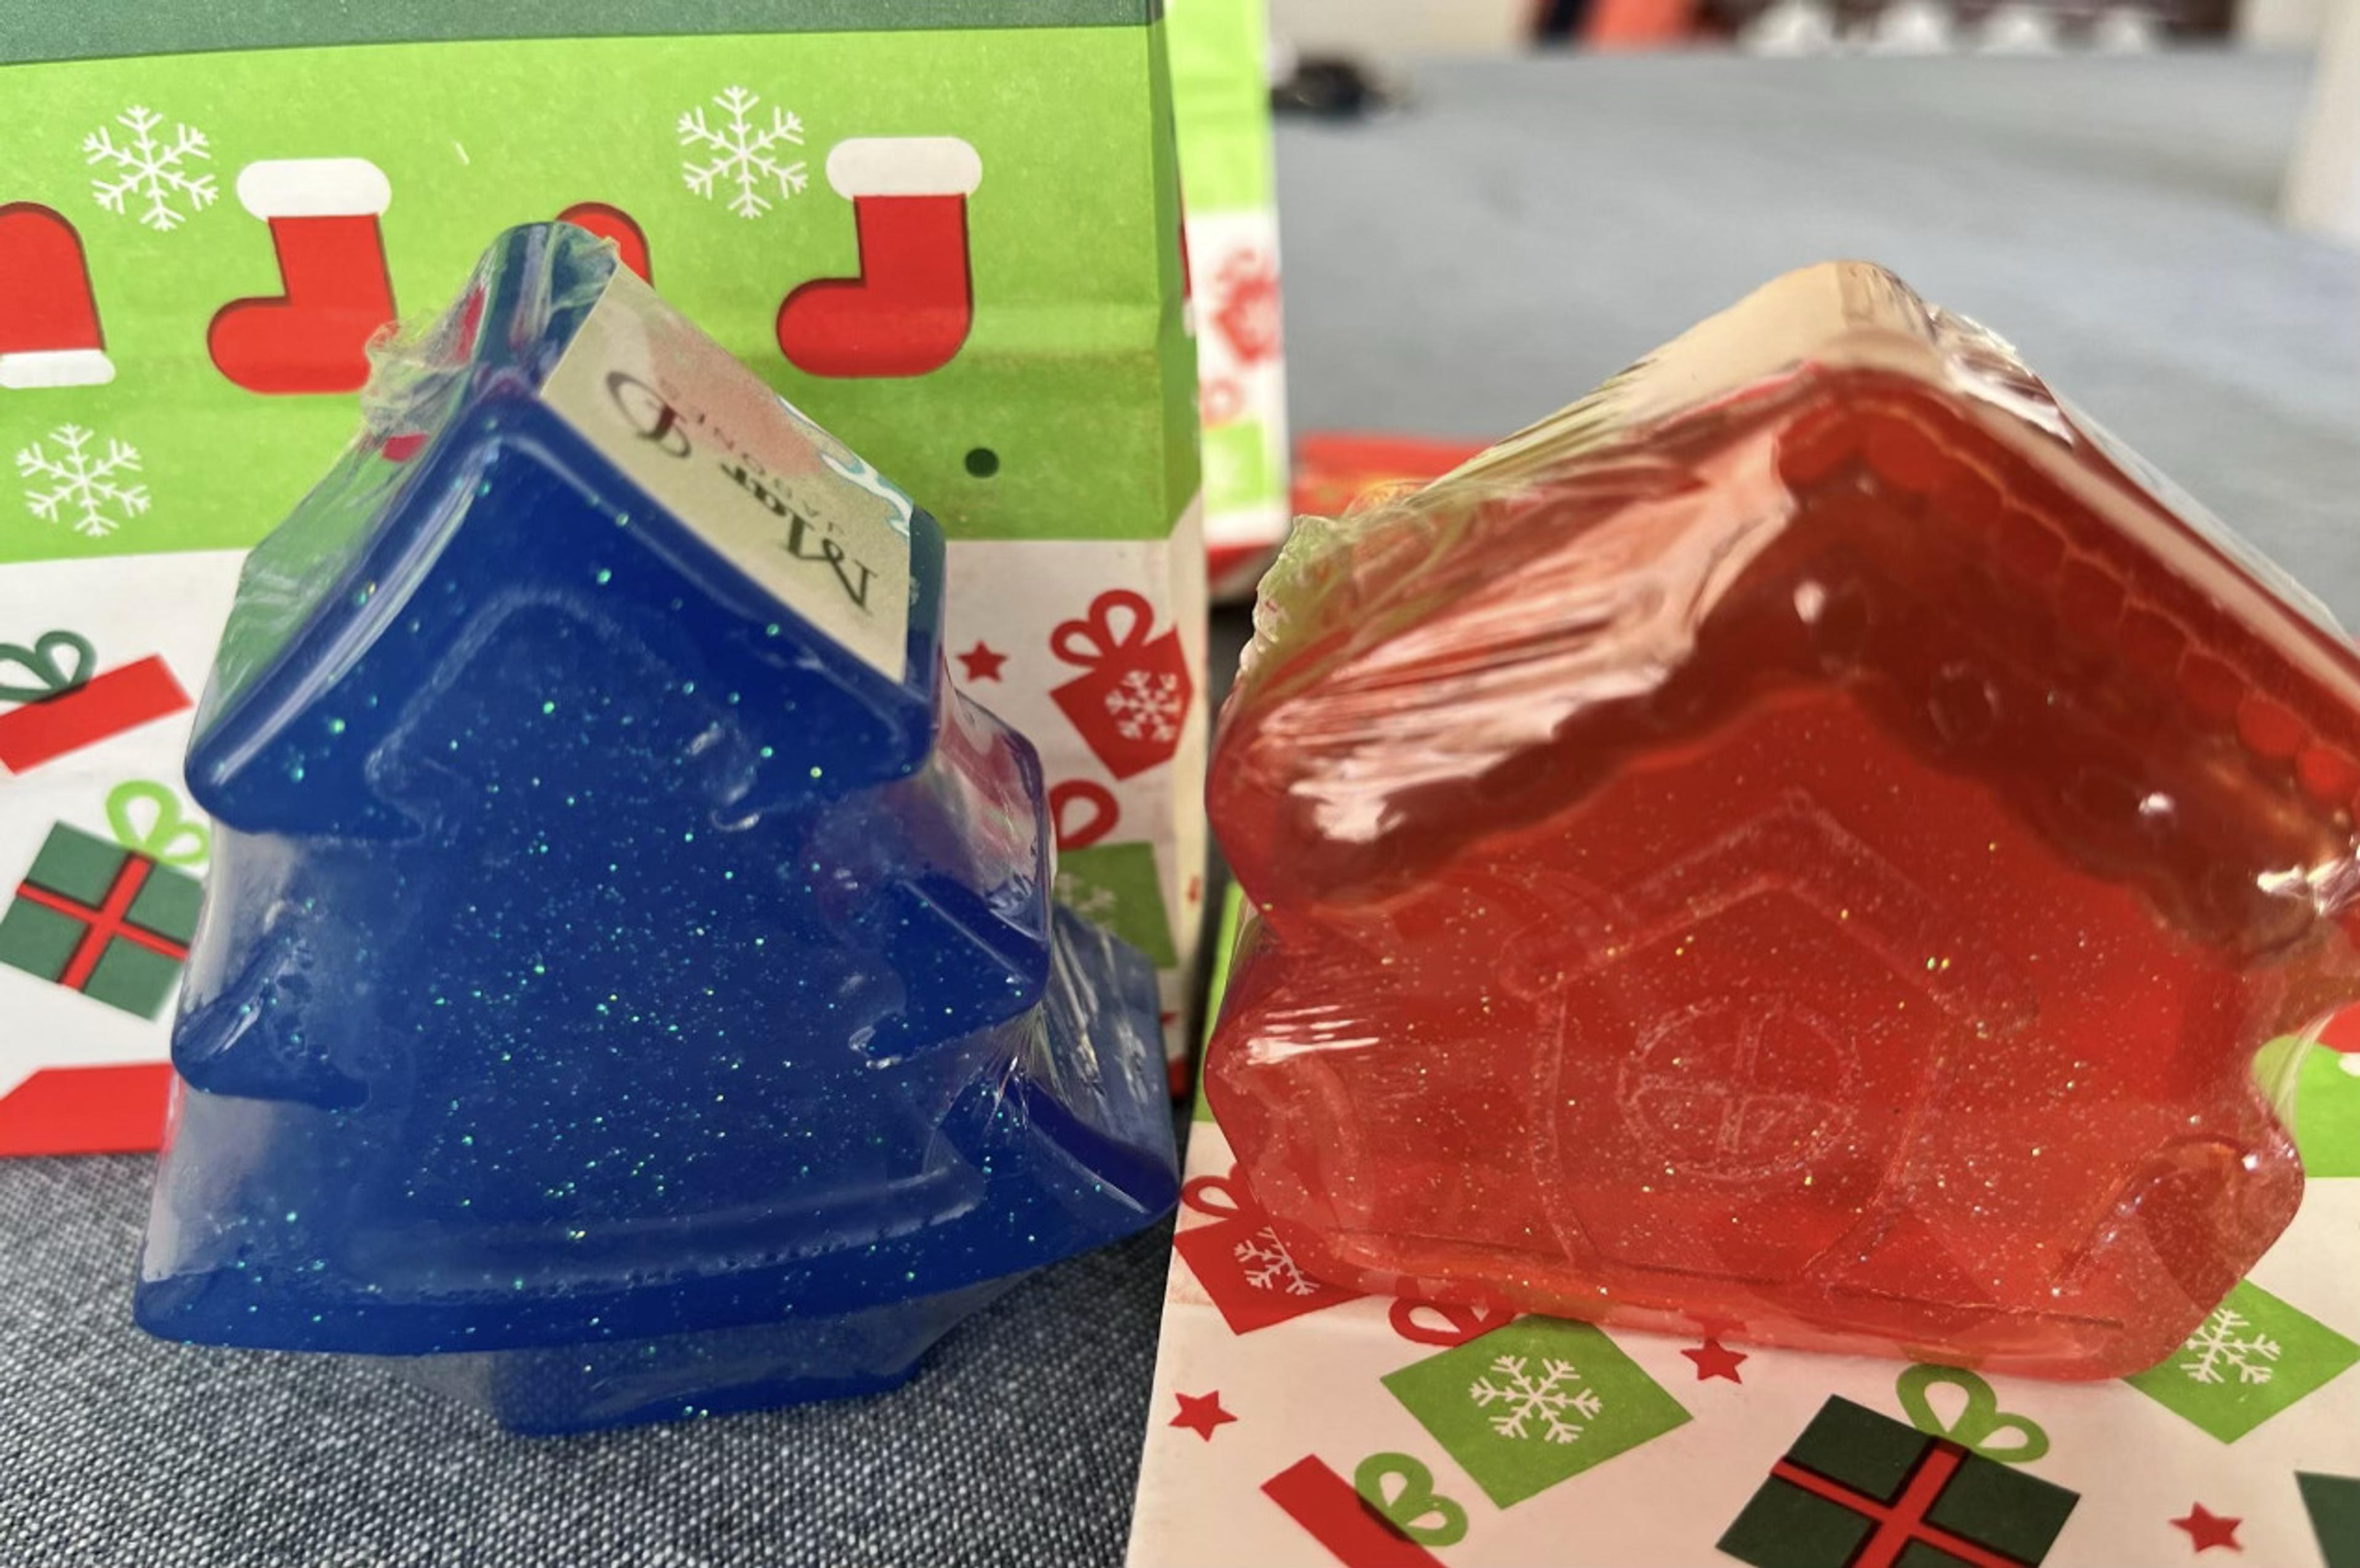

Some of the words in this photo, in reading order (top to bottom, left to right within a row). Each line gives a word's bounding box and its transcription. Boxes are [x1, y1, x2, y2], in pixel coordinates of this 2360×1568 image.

[605, 370, 692, 458] D
[661, 377, 844, 536] JABONES
[721, 462, 878, 614] Mar
